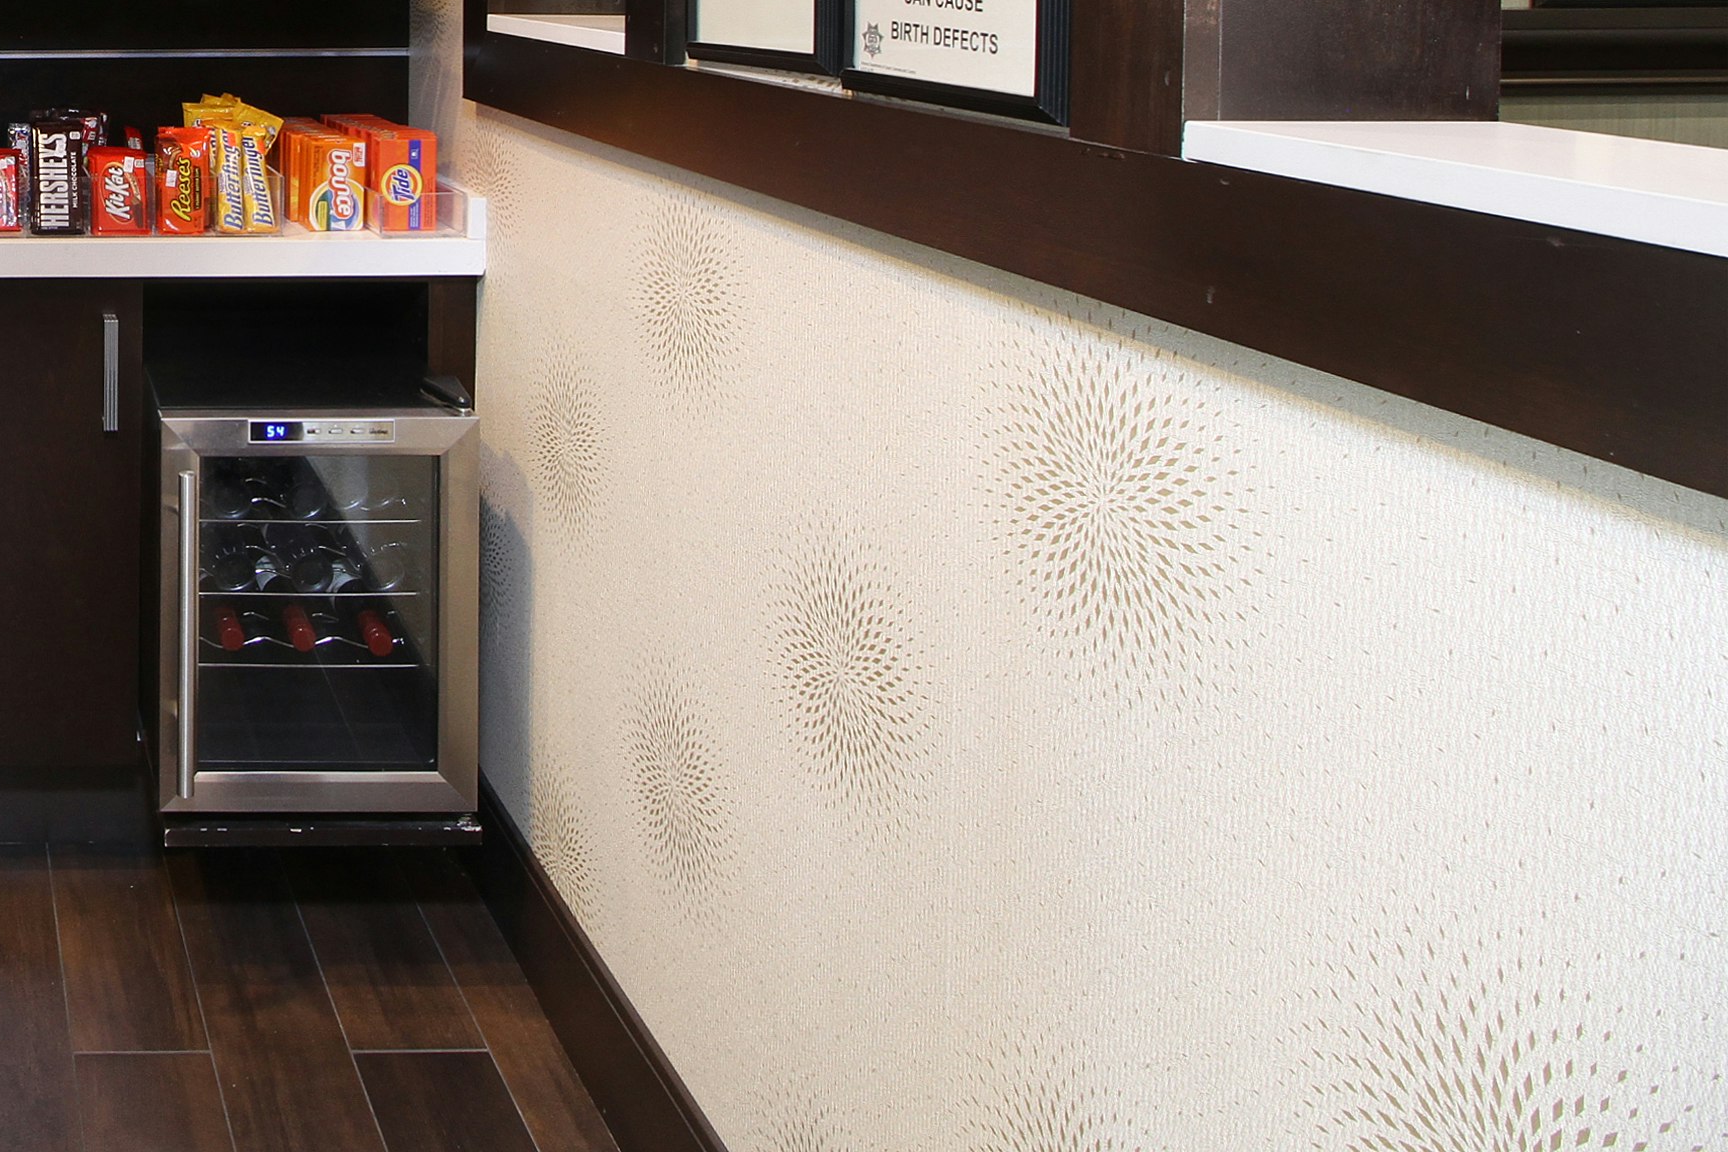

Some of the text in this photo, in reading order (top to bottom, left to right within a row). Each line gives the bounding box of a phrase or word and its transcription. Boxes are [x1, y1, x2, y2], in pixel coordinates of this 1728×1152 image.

[890, 21, 999, 55] BIRTH DEFECTS
[171, 156, 192, 221] Reese's
[330, 150, 353, 218] bounce
[392, 169, 415, 202] Tide
[267, 425, 286, 439] 54
